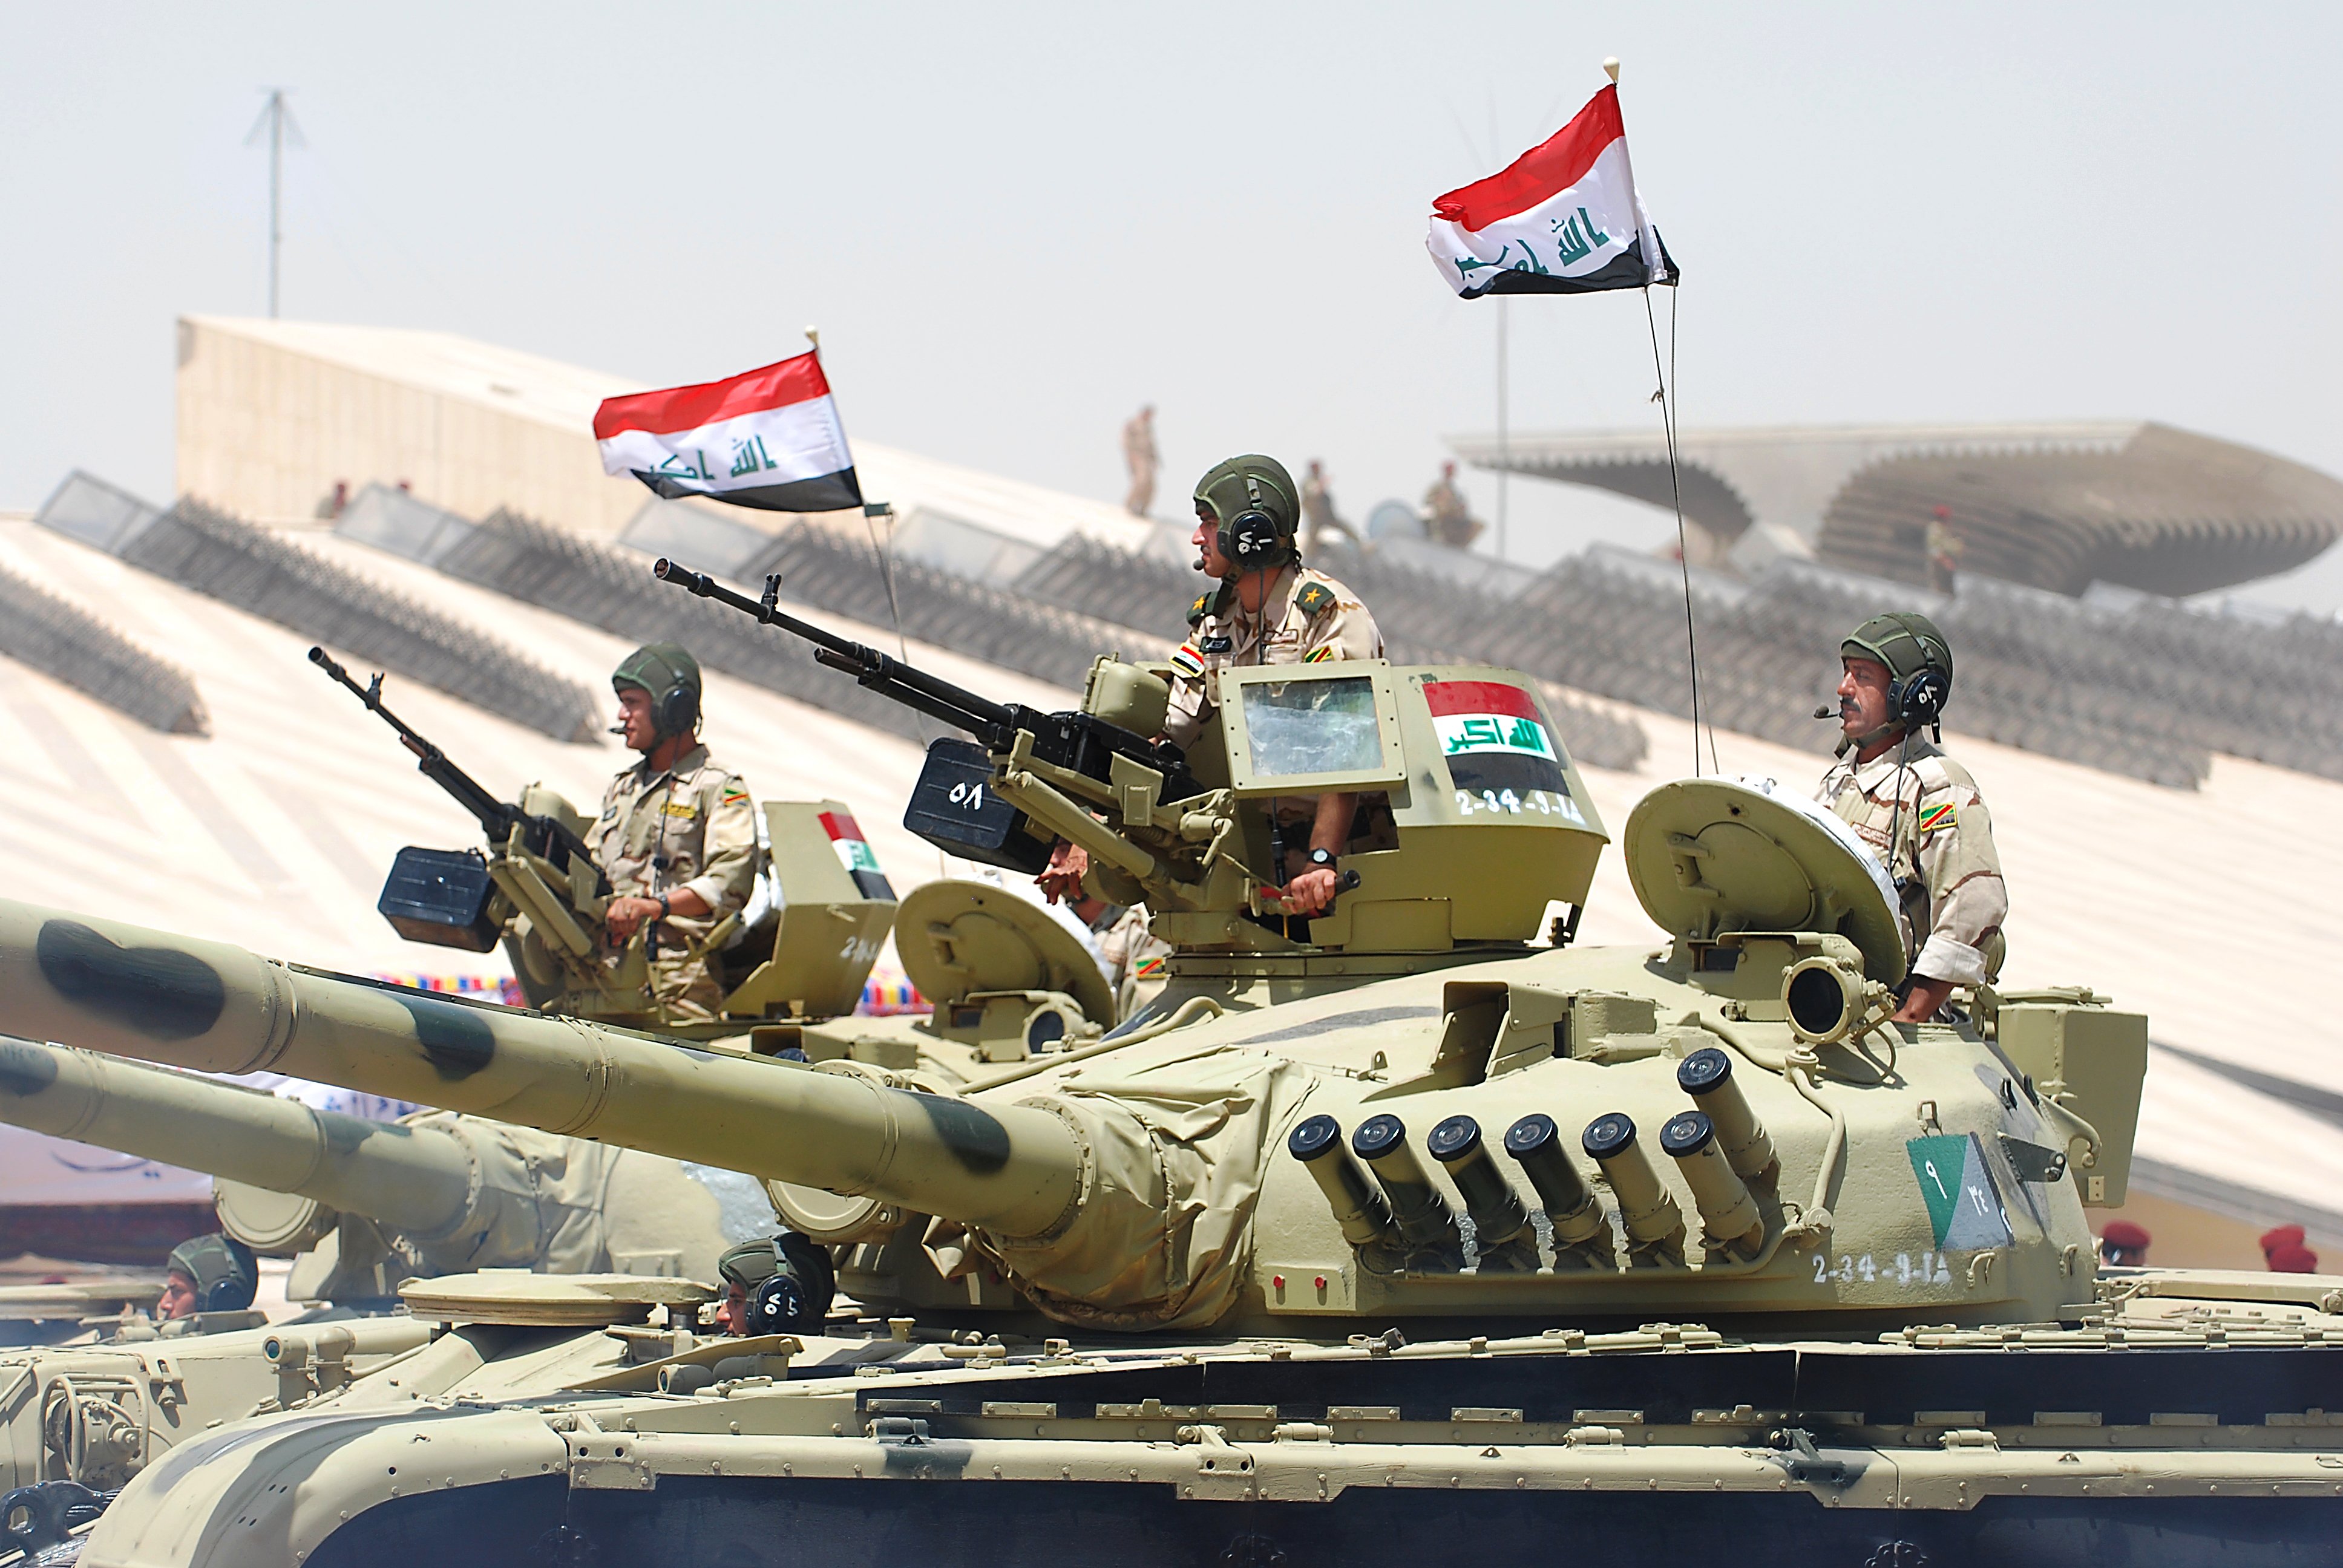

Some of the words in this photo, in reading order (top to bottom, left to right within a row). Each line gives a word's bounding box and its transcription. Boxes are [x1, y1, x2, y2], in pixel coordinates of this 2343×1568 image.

[1552, 206, 1610, 267] الله
[730, 434, 778, 478] الله
[1447, 717, 1506, 753] اكبر
[1509, 717, 1545, 753] الله
